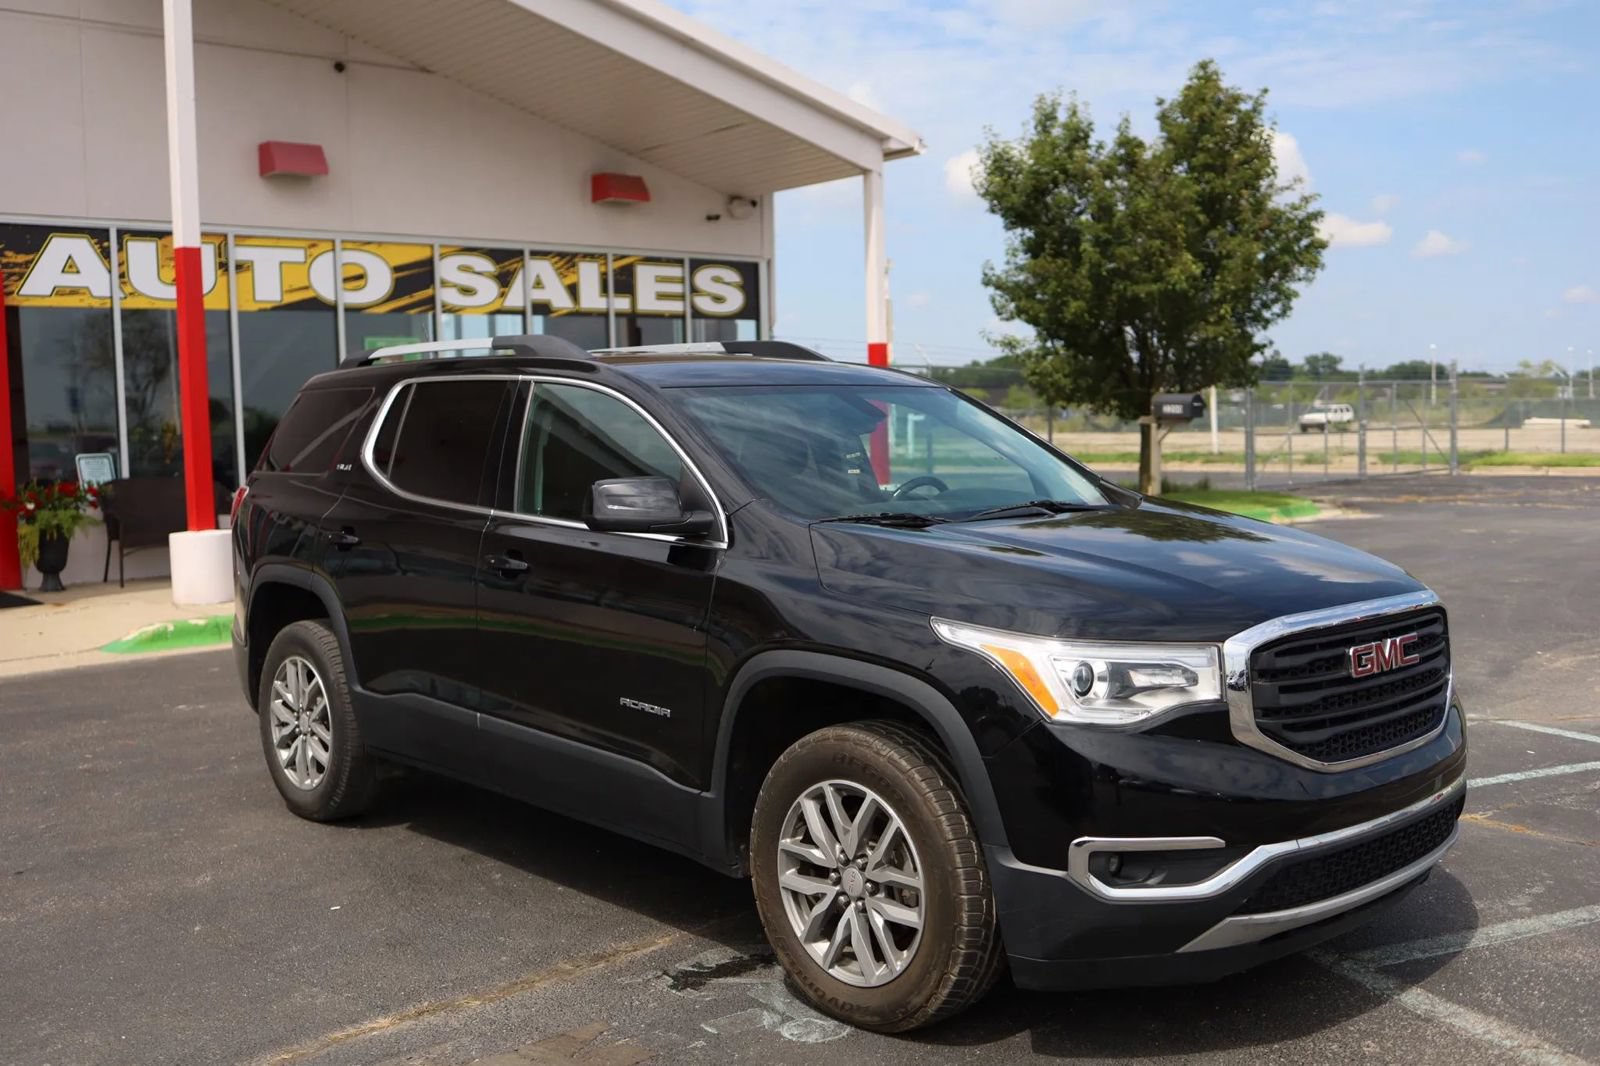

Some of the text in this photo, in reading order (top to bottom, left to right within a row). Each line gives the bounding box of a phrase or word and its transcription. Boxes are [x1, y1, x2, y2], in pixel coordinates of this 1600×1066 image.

[16, 233, 746, 316] AUTO SALES
[1349, 632, 1420, 678] GMC
[620, 696, 671, 718] ACADIA
